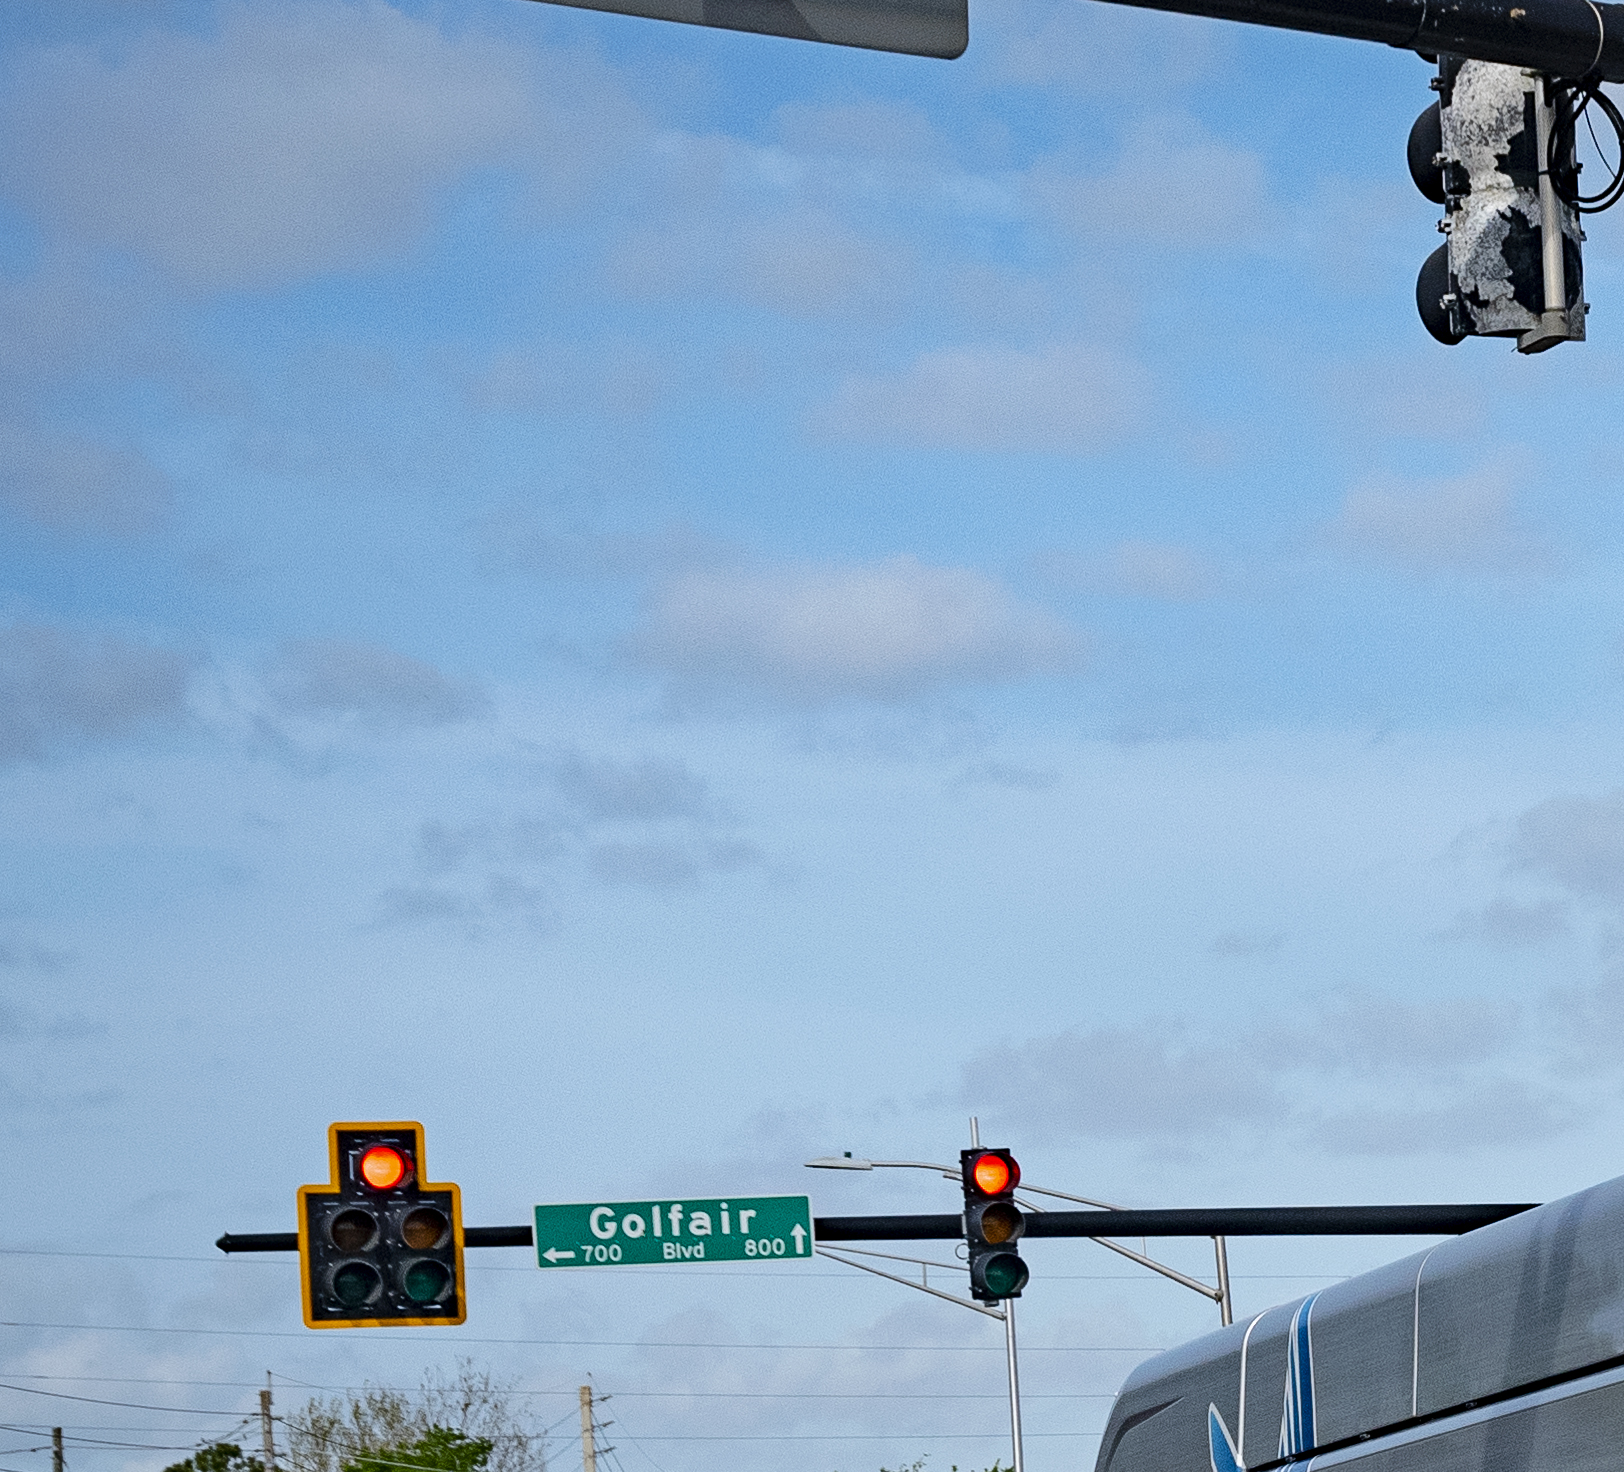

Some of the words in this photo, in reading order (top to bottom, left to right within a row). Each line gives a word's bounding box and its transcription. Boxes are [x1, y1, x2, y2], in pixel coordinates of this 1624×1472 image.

[589, 1202, 757, 1239] Golfair
[580, 1244, 622, 1263] 700
[662, 1242, 705, 1260] Blvd
[744, 1238, 786, 1257] 800
